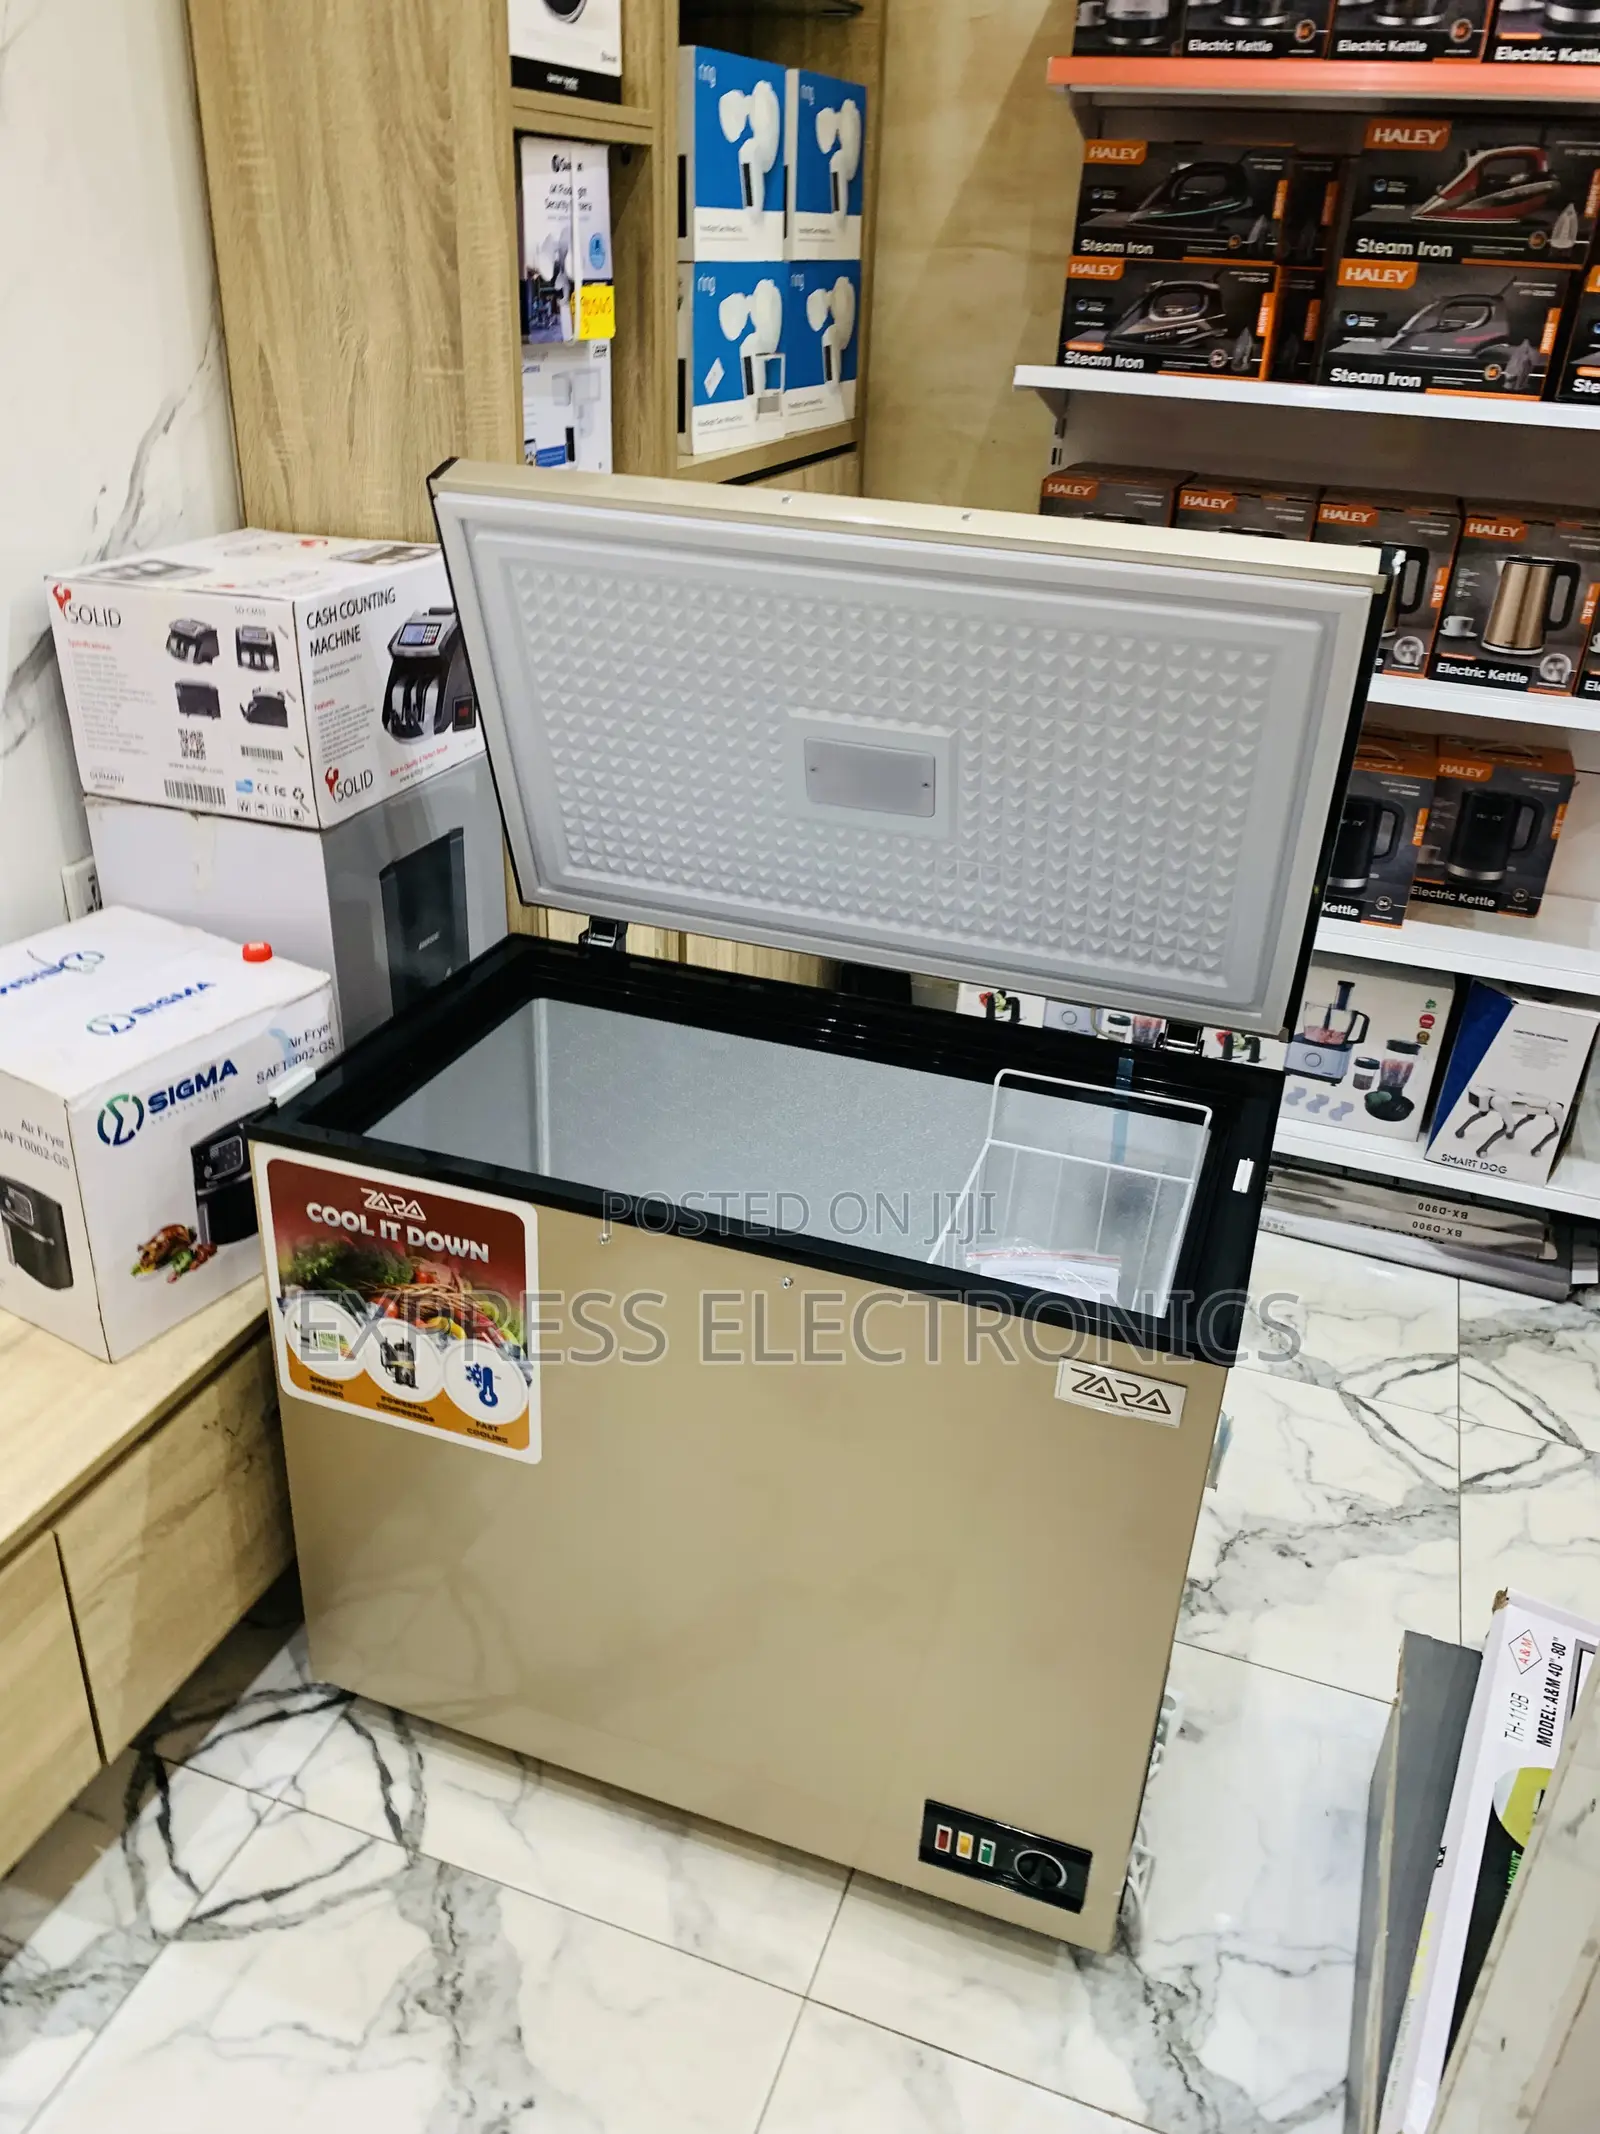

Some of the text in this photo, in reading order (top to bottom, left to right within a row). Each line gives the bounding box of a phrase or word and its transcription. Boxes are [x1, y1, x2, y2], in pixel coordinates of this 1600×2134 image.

[1187, 39, 1274, 52] Electric Kettle
[1336, 39, 1428, 52] Electric Kettle
[1494, 46, 1600, 63] Electric Kettl
[1374, 127, 1442, 145] HALEY
[1089, 146, 1141, 160] HALEY
[1080, 239, 1155, 256] Steam Iron
[1356, 237, 1414, 256] Steam
[1416, 240, 1454, 258] Iron
[1070, 263, 1120, 276] HALEY
[1345, 266, 1409, 284] HALEY
[1063, 350, 1113, 368] Steam
[1114, 354, 1145, 370] Iron
[1329, 367, 1386, 385] Steam
[1387, 371, 1422, 388] Iron
[1047, 483, 1092, 497] HALEY
[1183, 495, 1231, 510] HALEY
[1321, 508, 1371, 523] HALEY
[1468, 522, 1520, 538] HALEY
[67, 602, 122, 629] SOLID
[306, 586, 396, 630] CASH COUNTING
[309, 623, 361, 659] MACHINE
[1435, 661, 1529, 685] Electric Kettle
[1439, 763, 1485, 778] HALEY
[335, 768, 374, 802] SOLID
[1411, 885, 1496, 907] Electric Kettle
[1321, 901, 1360, 917] Kettle
[304, 1020, 333, 1047] Fryer
[147, 1058, 239, 1115] SIGMA
[21, 1118, 65, 1150] Air Fryer
[1440, 1152, 1508, 1175] SMART DOG
[360, 1186, 428, 1224] ZARA
[1417, 1201, 1469, 1220] BX-D900
[306, 1201, 490, 1265] COOL IT DOWN
[1411, 1220, 1463, 1238] BX-D900
[309, 1374, 345, 1391] ENERGY
[310, 1384, 345, 1399] SAVING
[1070, 1366, 1172, 1415] ZARA
[466, 1426, 509, 1445] COOLING
[475, 1420, 500, 1434] FAST
[1542, 1676, 1562, 1705] A&M
[1503, 1691, 1530, 1743] TH-119B
[1535, 1704, 1558, 1748] MODEL:
